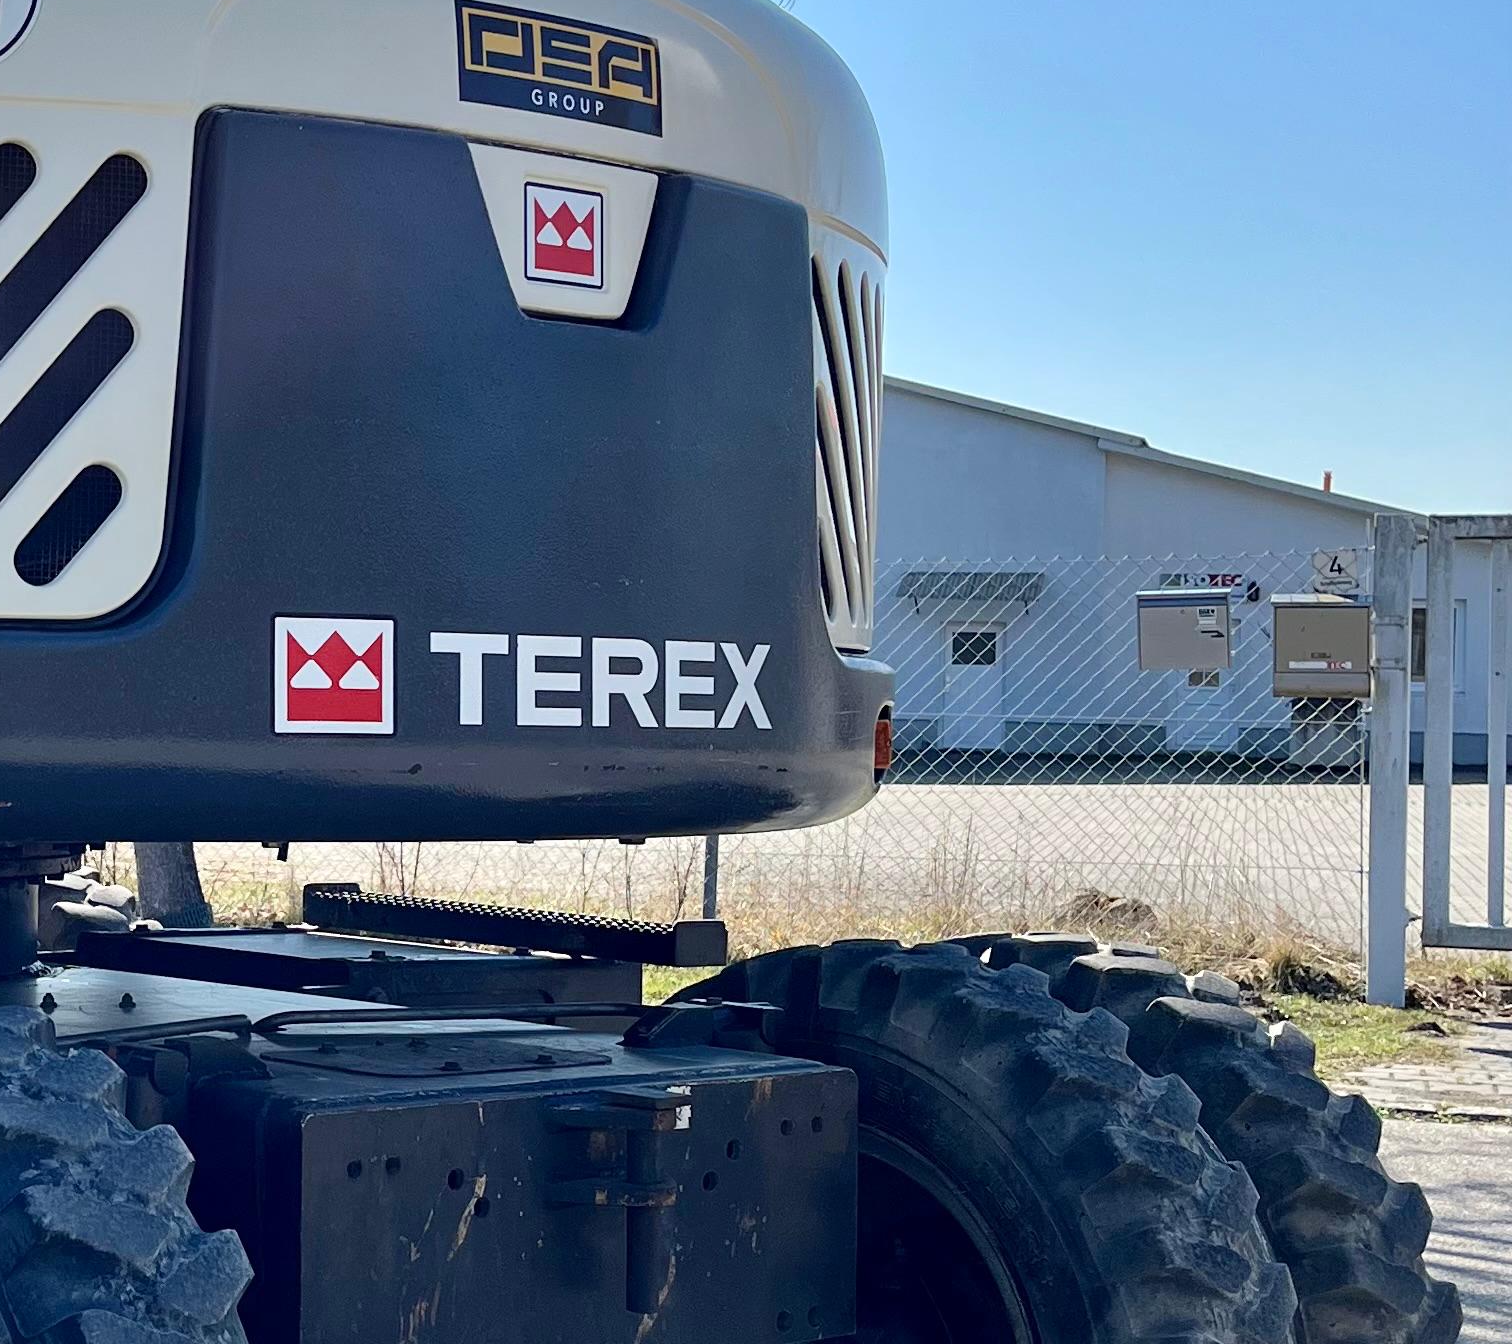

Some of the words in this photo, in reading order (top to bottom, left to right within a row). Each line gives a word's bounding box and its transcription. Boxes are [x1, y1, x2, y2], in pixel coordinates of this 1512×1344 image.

[531, 88, 605, 117] GROUP
[1329, 556, 1343, 575] 4
[429, 631, 774, 730] TEREX
